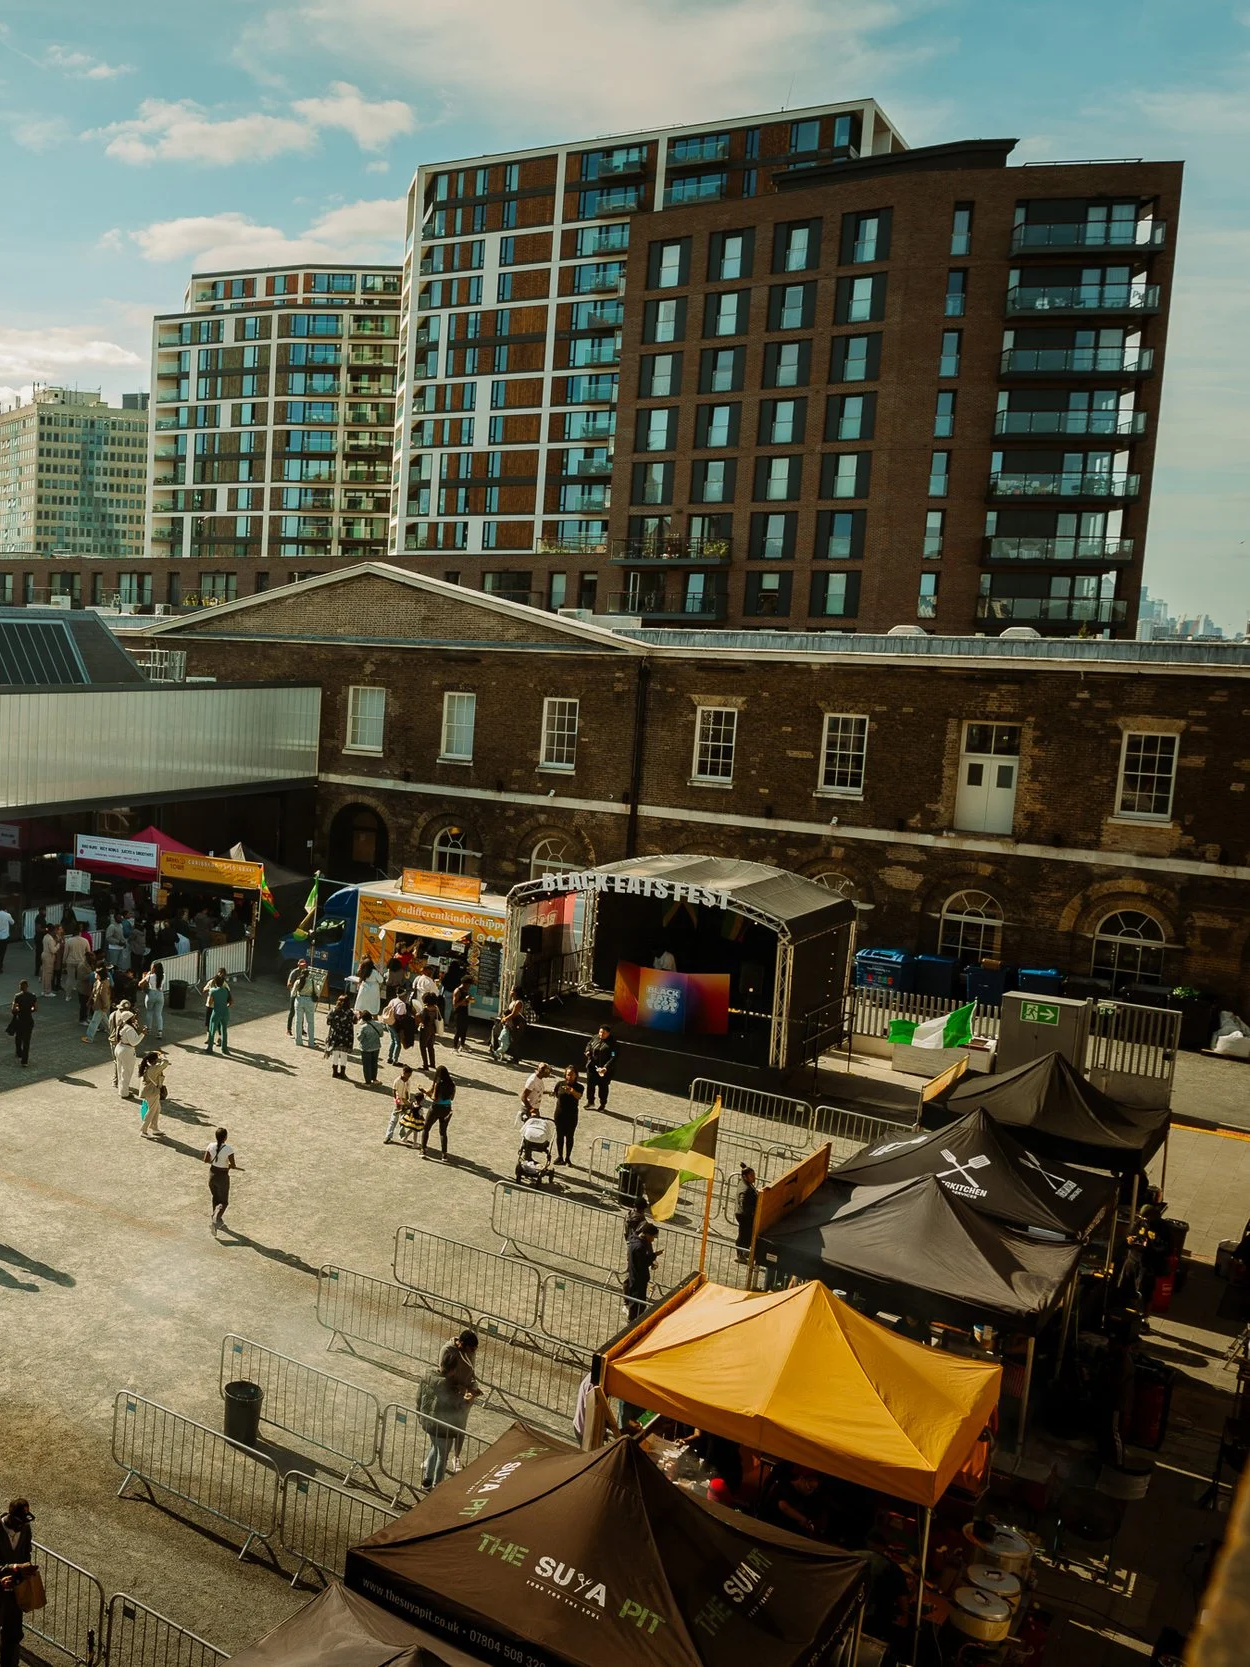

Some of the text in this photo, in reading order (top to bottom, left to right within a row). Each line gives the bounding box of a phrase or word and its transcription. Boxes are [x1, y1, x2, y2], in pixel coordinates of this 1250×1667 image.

[541, 871, 732, 910] BLACK EATS FEST
[397, 905, 505, 932] #adifferentkindofchippy
[647, 986, 680, 998] BLACK
[650, 993, 676, 1003] EATS
[477, 1532, 666, 1635] THE SUYA PIT
[526, 1579, 600, 1620] FOOD FOR THE SOUL
[723, 1561, 761, 1603] SUA
[362, 1577, 460, 1635] www.thesuyapit.co.uk
[469, 1629, 501, 1654] 07804
[503, 1645, 524, 1664] 508
